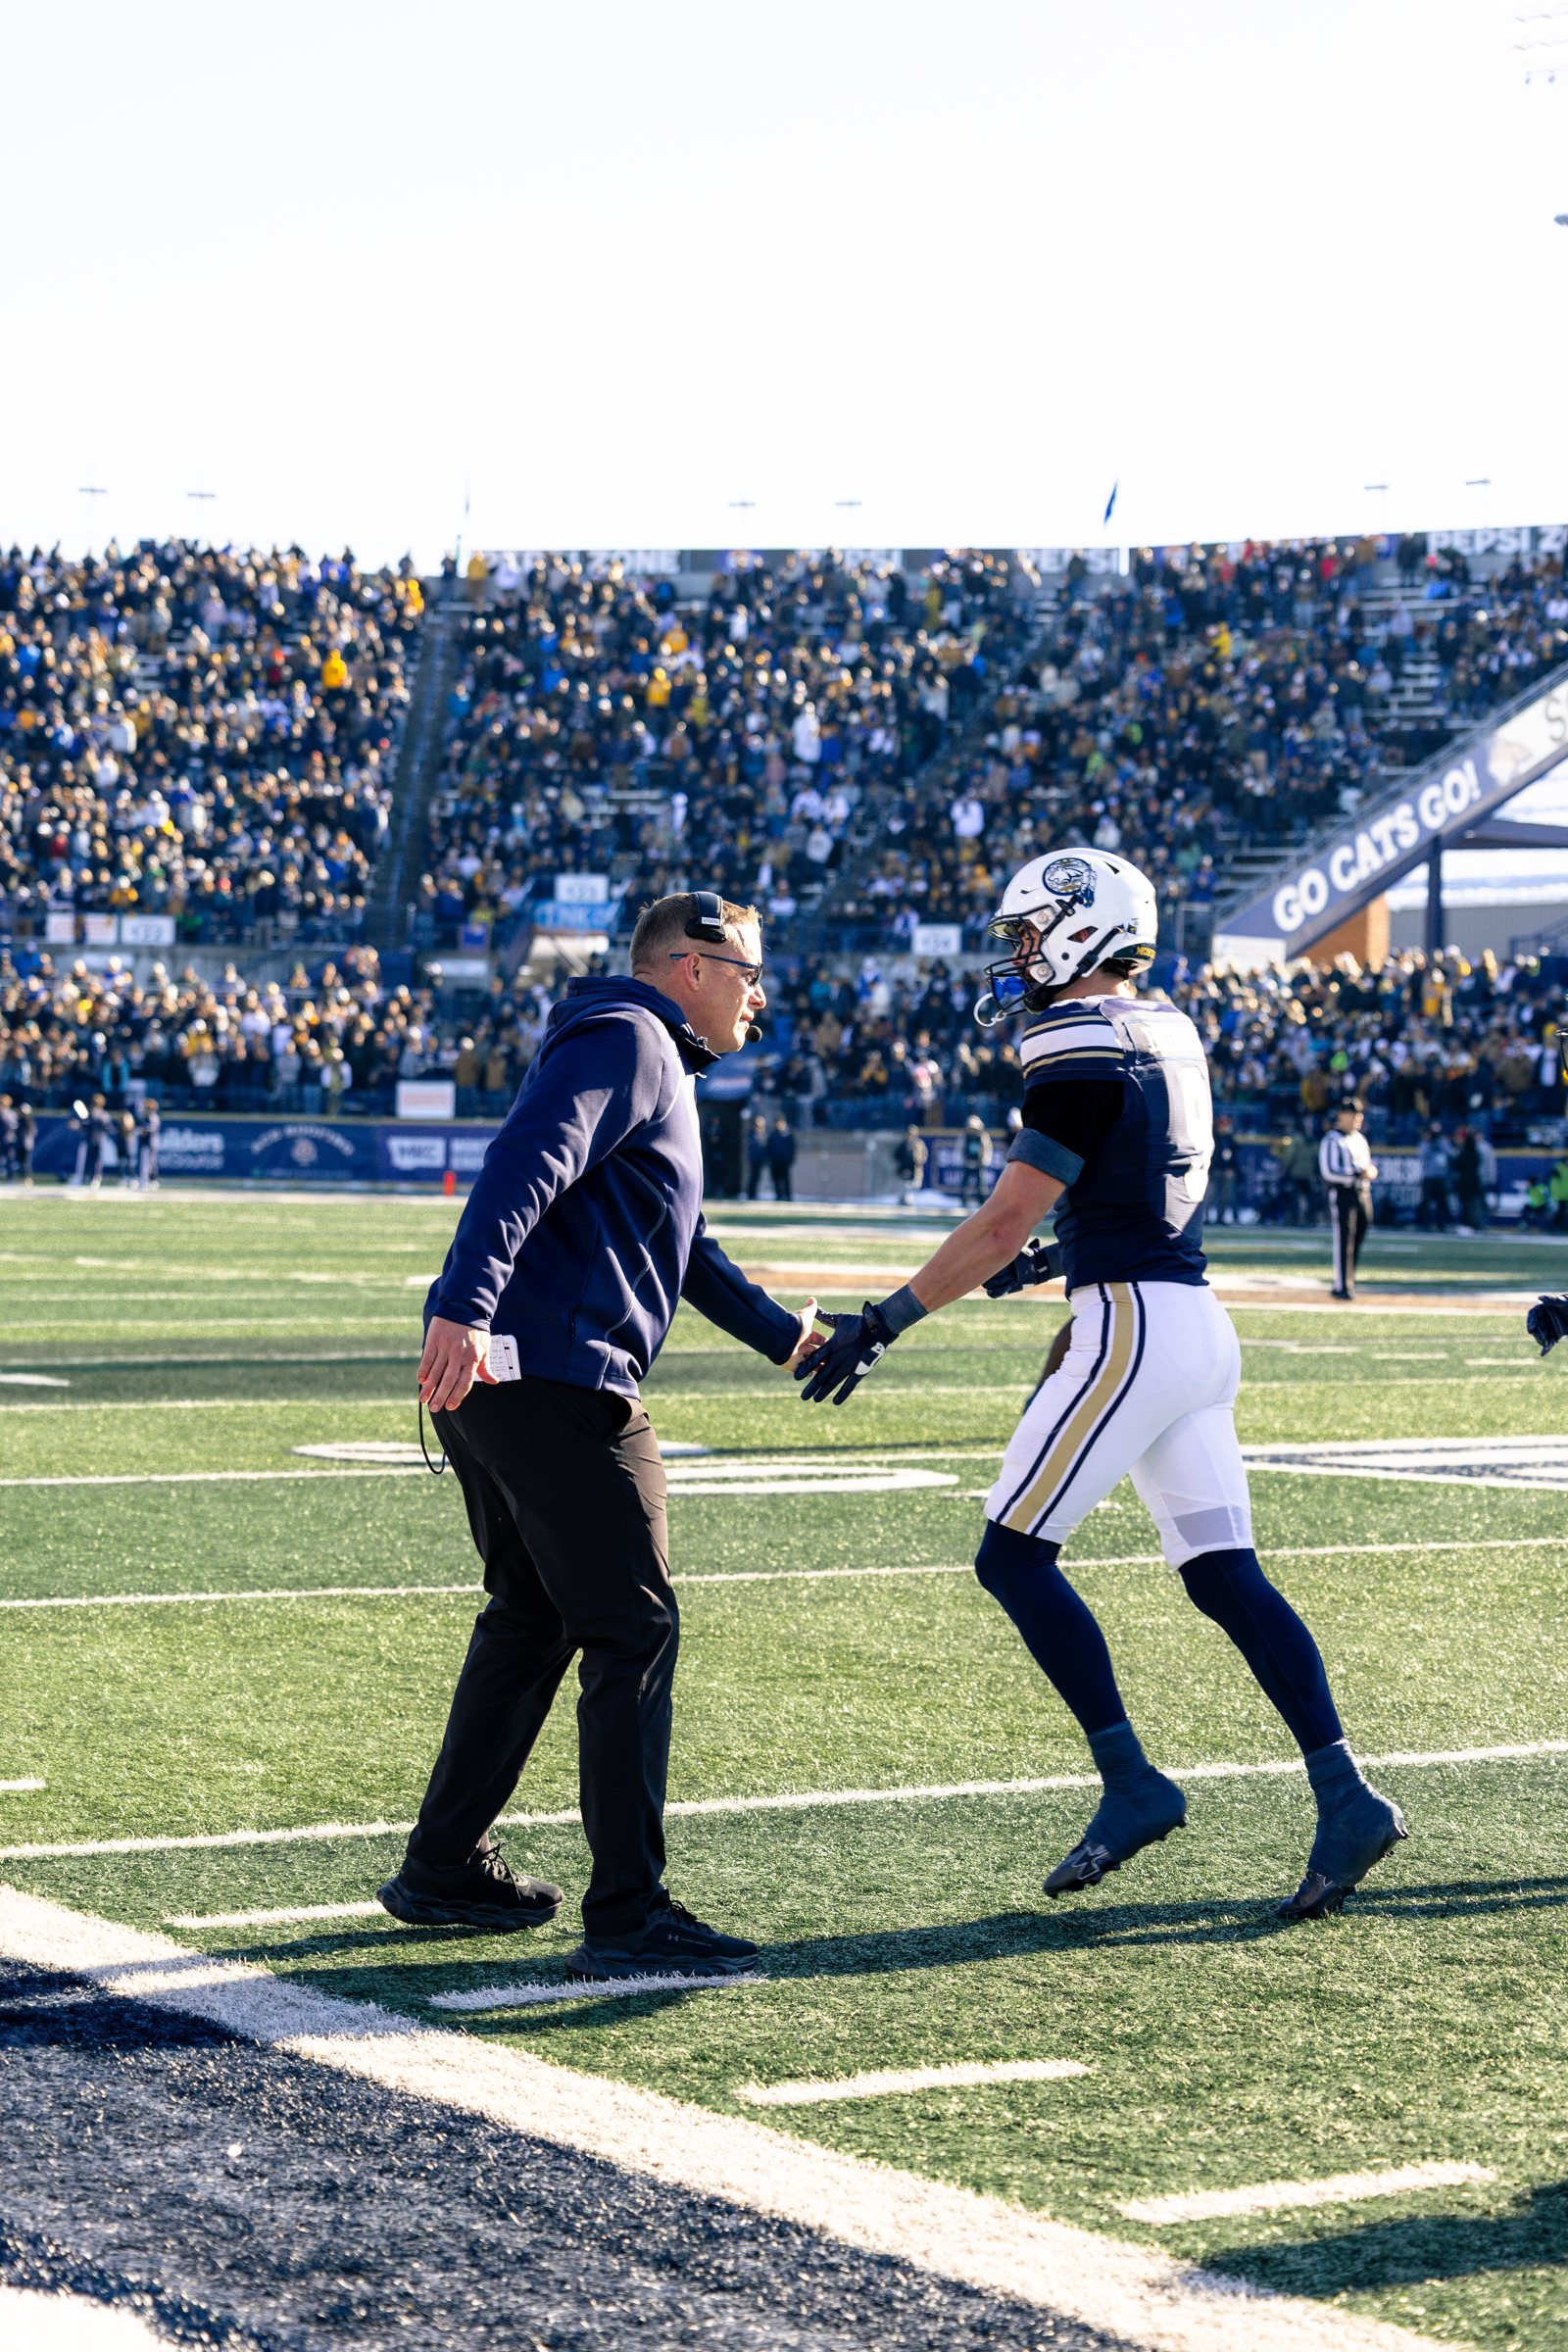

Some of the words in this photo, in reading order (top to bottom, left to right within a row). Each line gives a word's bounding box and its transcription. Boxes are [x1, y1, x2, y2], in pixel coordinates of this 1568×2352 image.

[1427, 527, 1532, 556] PEPSI
[589, 551, 679, 575] ZONE
[1273, 868, 1329, 932] GO
[1330, 803, 1420, 893] CATS
[1418, 760, 1482, 830] GO!
